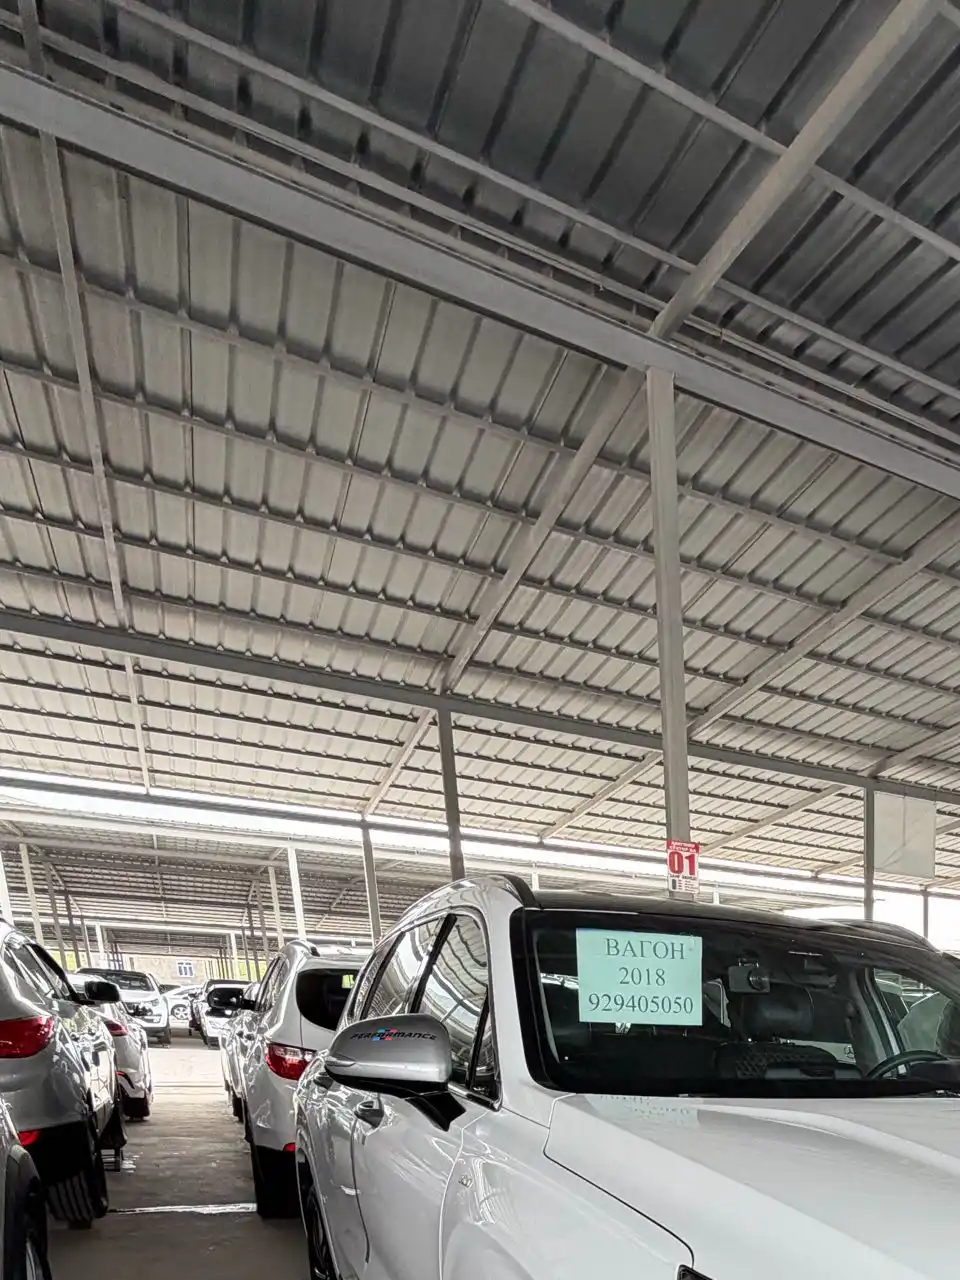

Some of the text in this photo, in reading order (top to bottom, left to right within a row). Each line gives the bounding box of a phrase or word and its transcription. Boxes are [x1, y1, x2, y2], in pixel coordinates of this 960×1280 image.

[669, 851, 696, 876] 01
[605, 937, 687, 960] ВАГОН
[618, 966, 666, 986] 2018
[588, 993, 694, 1014] 929405050
